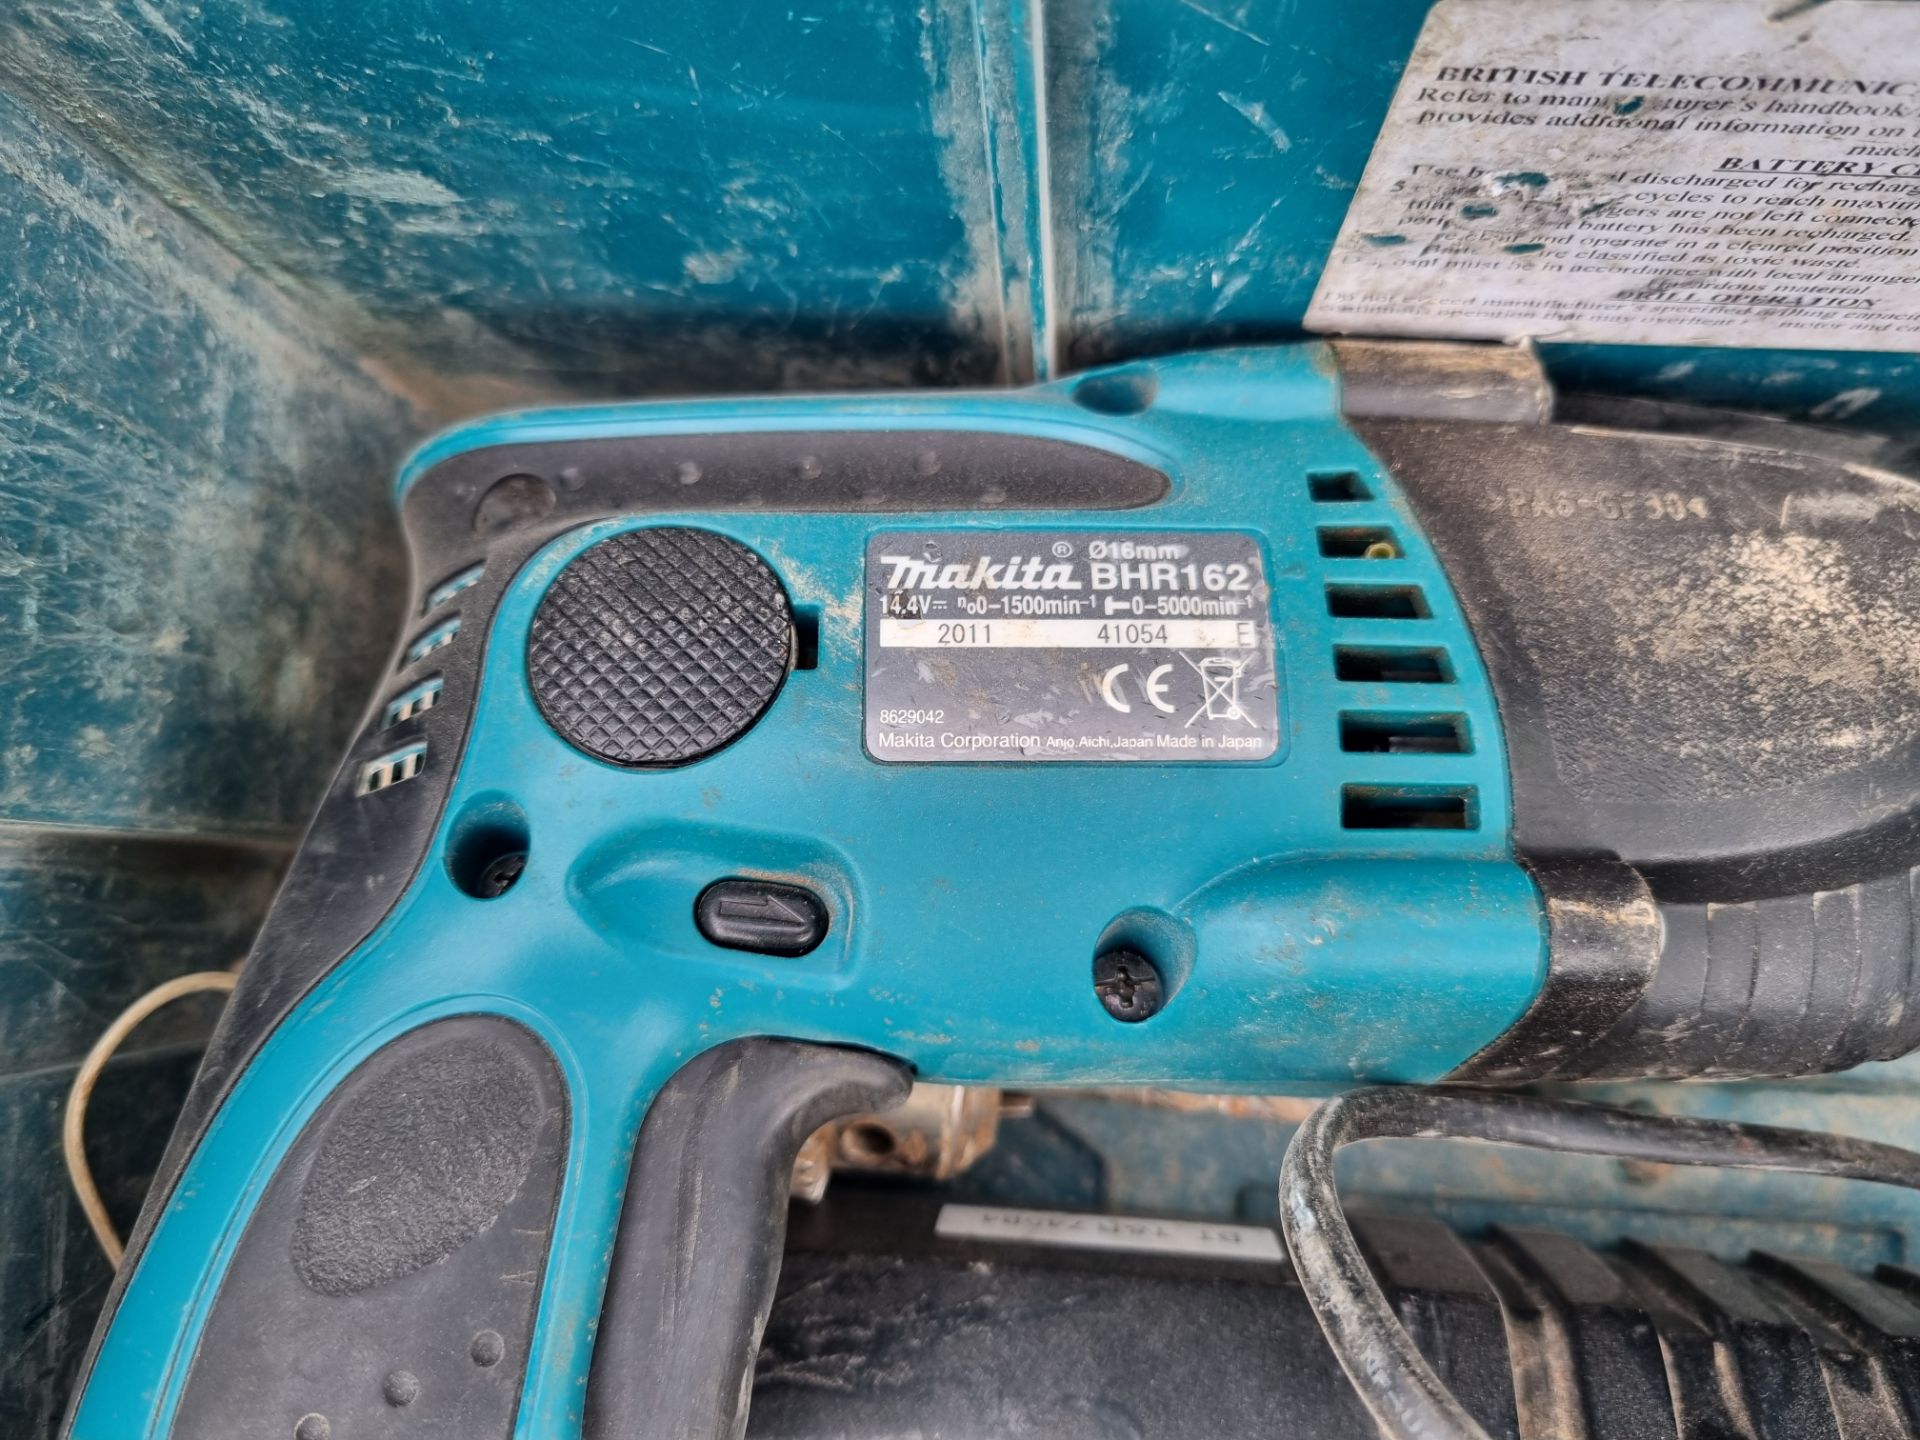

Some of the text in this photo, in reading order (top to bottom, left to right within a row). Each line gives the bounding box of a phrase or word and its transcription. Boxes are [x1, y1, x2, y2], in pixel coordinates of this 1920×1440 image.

[1436, 67, 1588, 87] BRITISH
[1419, 88, 1496, 104] Refer
[1503, 92, 1530, 105] to
[1416, 110, 1538, 127] provides
[1695, 119, 1860, 137] information
[1868, 126, 1905, 137] on
[1718, 157, 1886, 175] BATTERY
[1630, 172, 1777, 192] discharged
[1782, 178, 1824, 191] for
[1635, 190, 1713, 205] cycles
[1721, 194, 1747, 207] to
[1754, 196, 1825, 208] reach
[1666, 208, 1707, 219] are
[1761, 209, 1804, 222] left
[1578, 220, 1664, 236] battery
[1669, 223, 1712, 235] has
[1718, 225, 1777, 237] been
[1579, 237, 1668, 249] operate
[1727, 242, 1816, 254] cleared
[1815, 244, 1919, 257] position
[1575, 250, 1684, 263] classified
[1723, 254, 1784, 265] toxic
[1569, 263, 1700, 277] accordance
[1763, 269, 1823, 281] local
[879, 554, 1082, 590] Makita
[1090, 563, 1250, 591] BHR162
[879, 595, 932, 615] 14.4V
[937, 623, 992, 644] 2011
[1097, 623, 1169, 644] 41054
[879, 709, 945, 725] 8629042
[878, 732, 935, 749] Makita
[940, 732, 1041, 750] Corporation
[1156, 734, 1197, 749] Made
[1201, 735, 1214, 748] in
[1217, 735, 1263, 750] Japan
